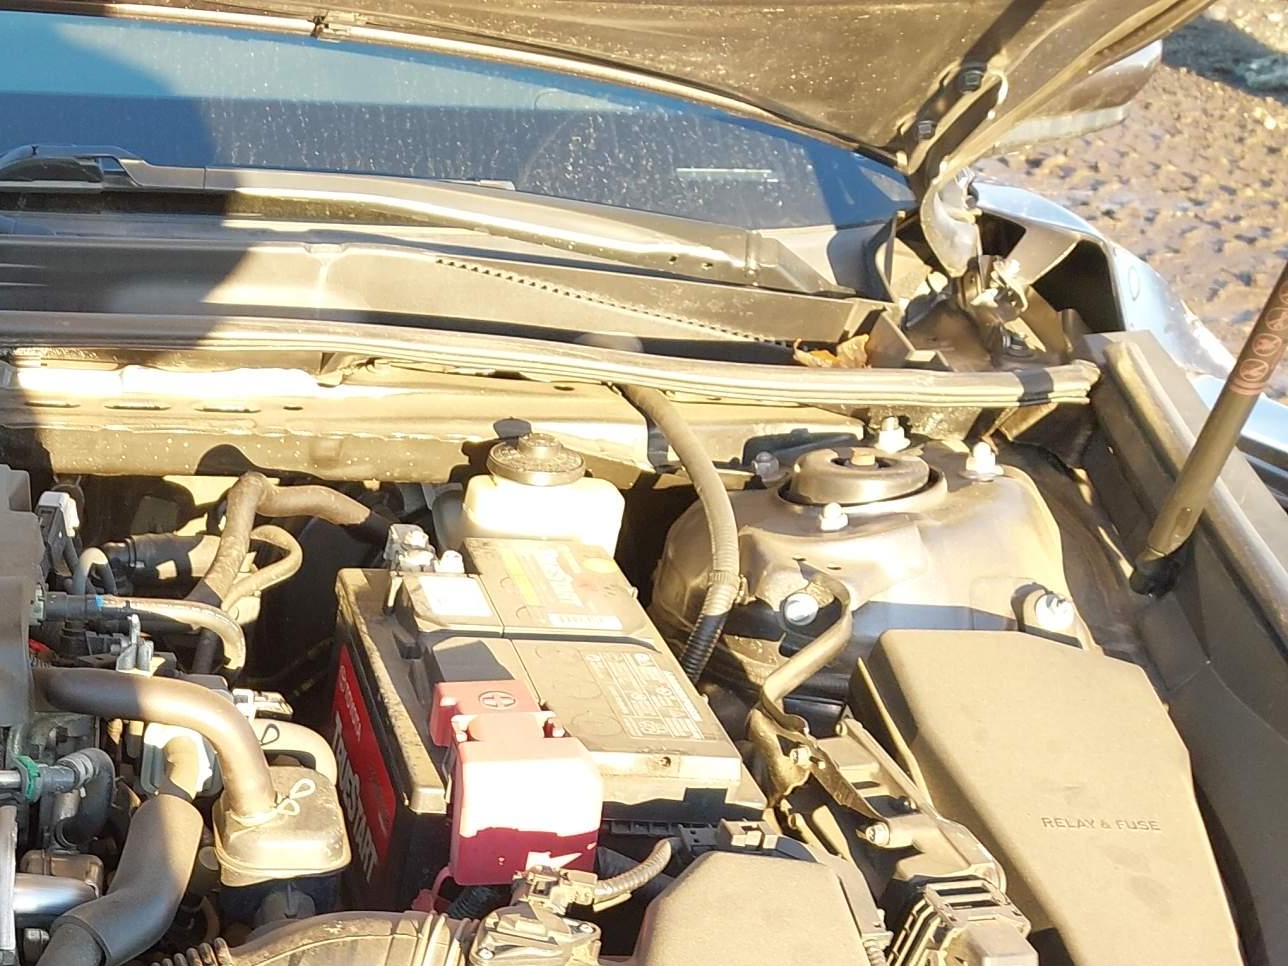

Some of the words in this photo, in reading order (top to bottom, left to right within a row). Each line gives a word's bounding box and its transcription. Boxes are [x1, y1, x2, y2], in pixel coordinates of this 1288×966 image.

[1040, 816, 1096, 829] RELAY
[1099, 818, 1113, 830] &
[1115, 818, 1162, 831] FUSE
